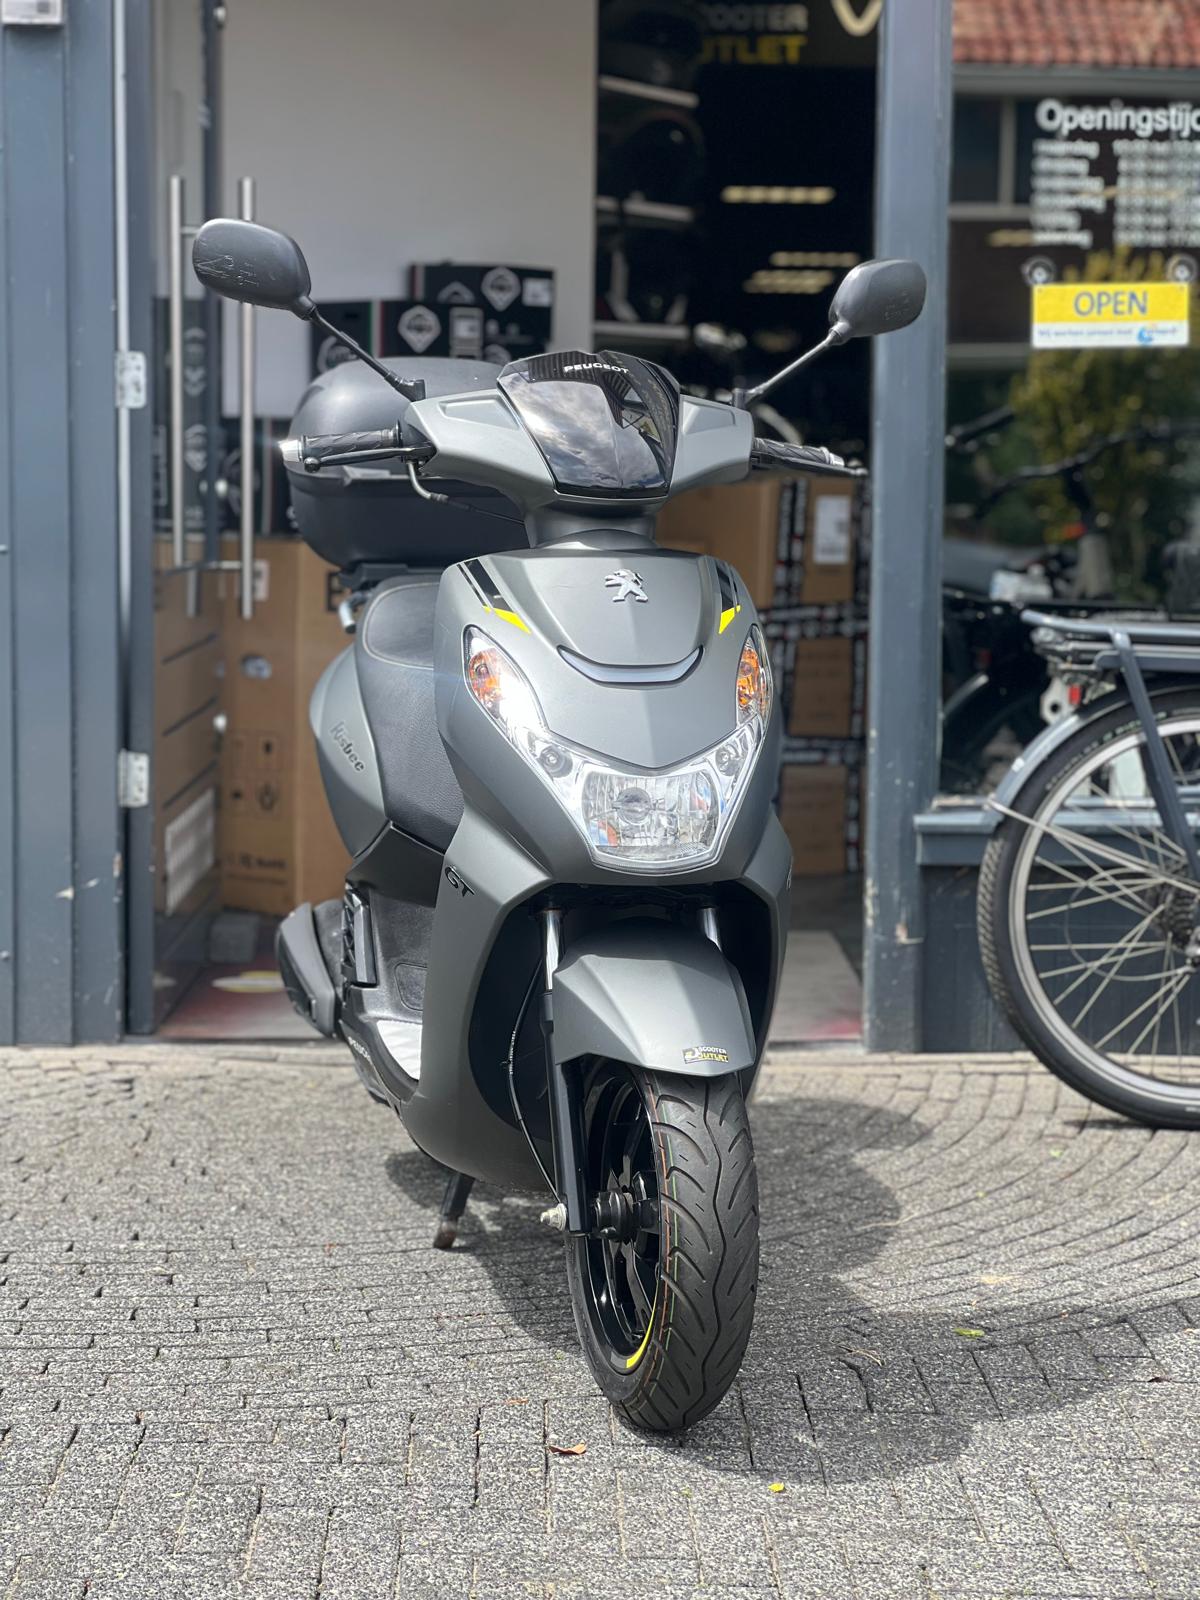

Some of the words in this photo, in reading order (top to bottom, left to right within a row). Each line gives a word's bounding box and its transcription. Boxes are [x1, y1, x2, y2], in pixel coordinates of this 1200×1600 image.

[1073, 291, 1148, 316] OPEN
[563, 362, 629, 374] PEUGEOT
[444, 866, 475, 898] GT
[698, 1046, 727, 1054] SCOOTER
